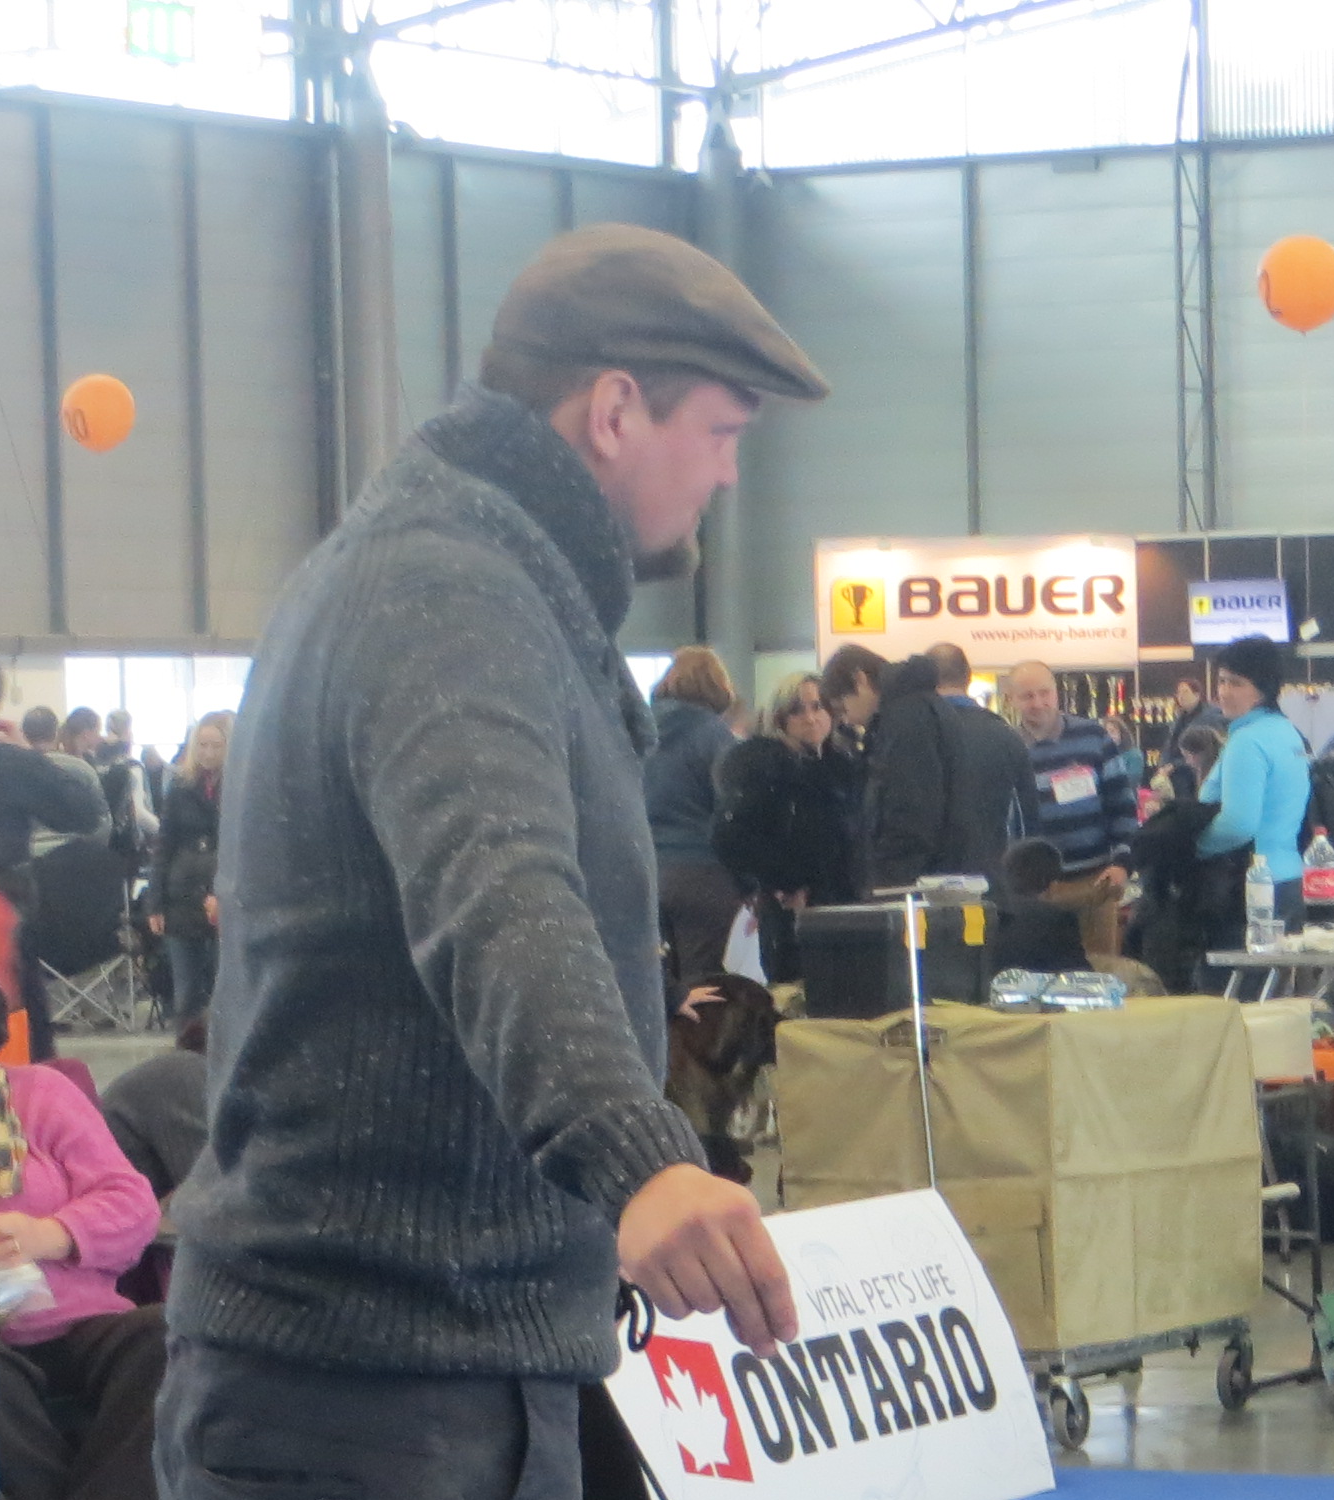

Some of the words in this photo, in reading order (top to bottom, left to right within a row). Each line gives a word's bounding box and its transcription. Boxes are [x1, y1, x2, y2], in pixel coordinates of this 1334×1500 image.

[806, 1283, 864, 1321] VITAL
[914, 1263, 957, 1300] LIFE
[732, 1307, 997, 1464] ONTARIO
